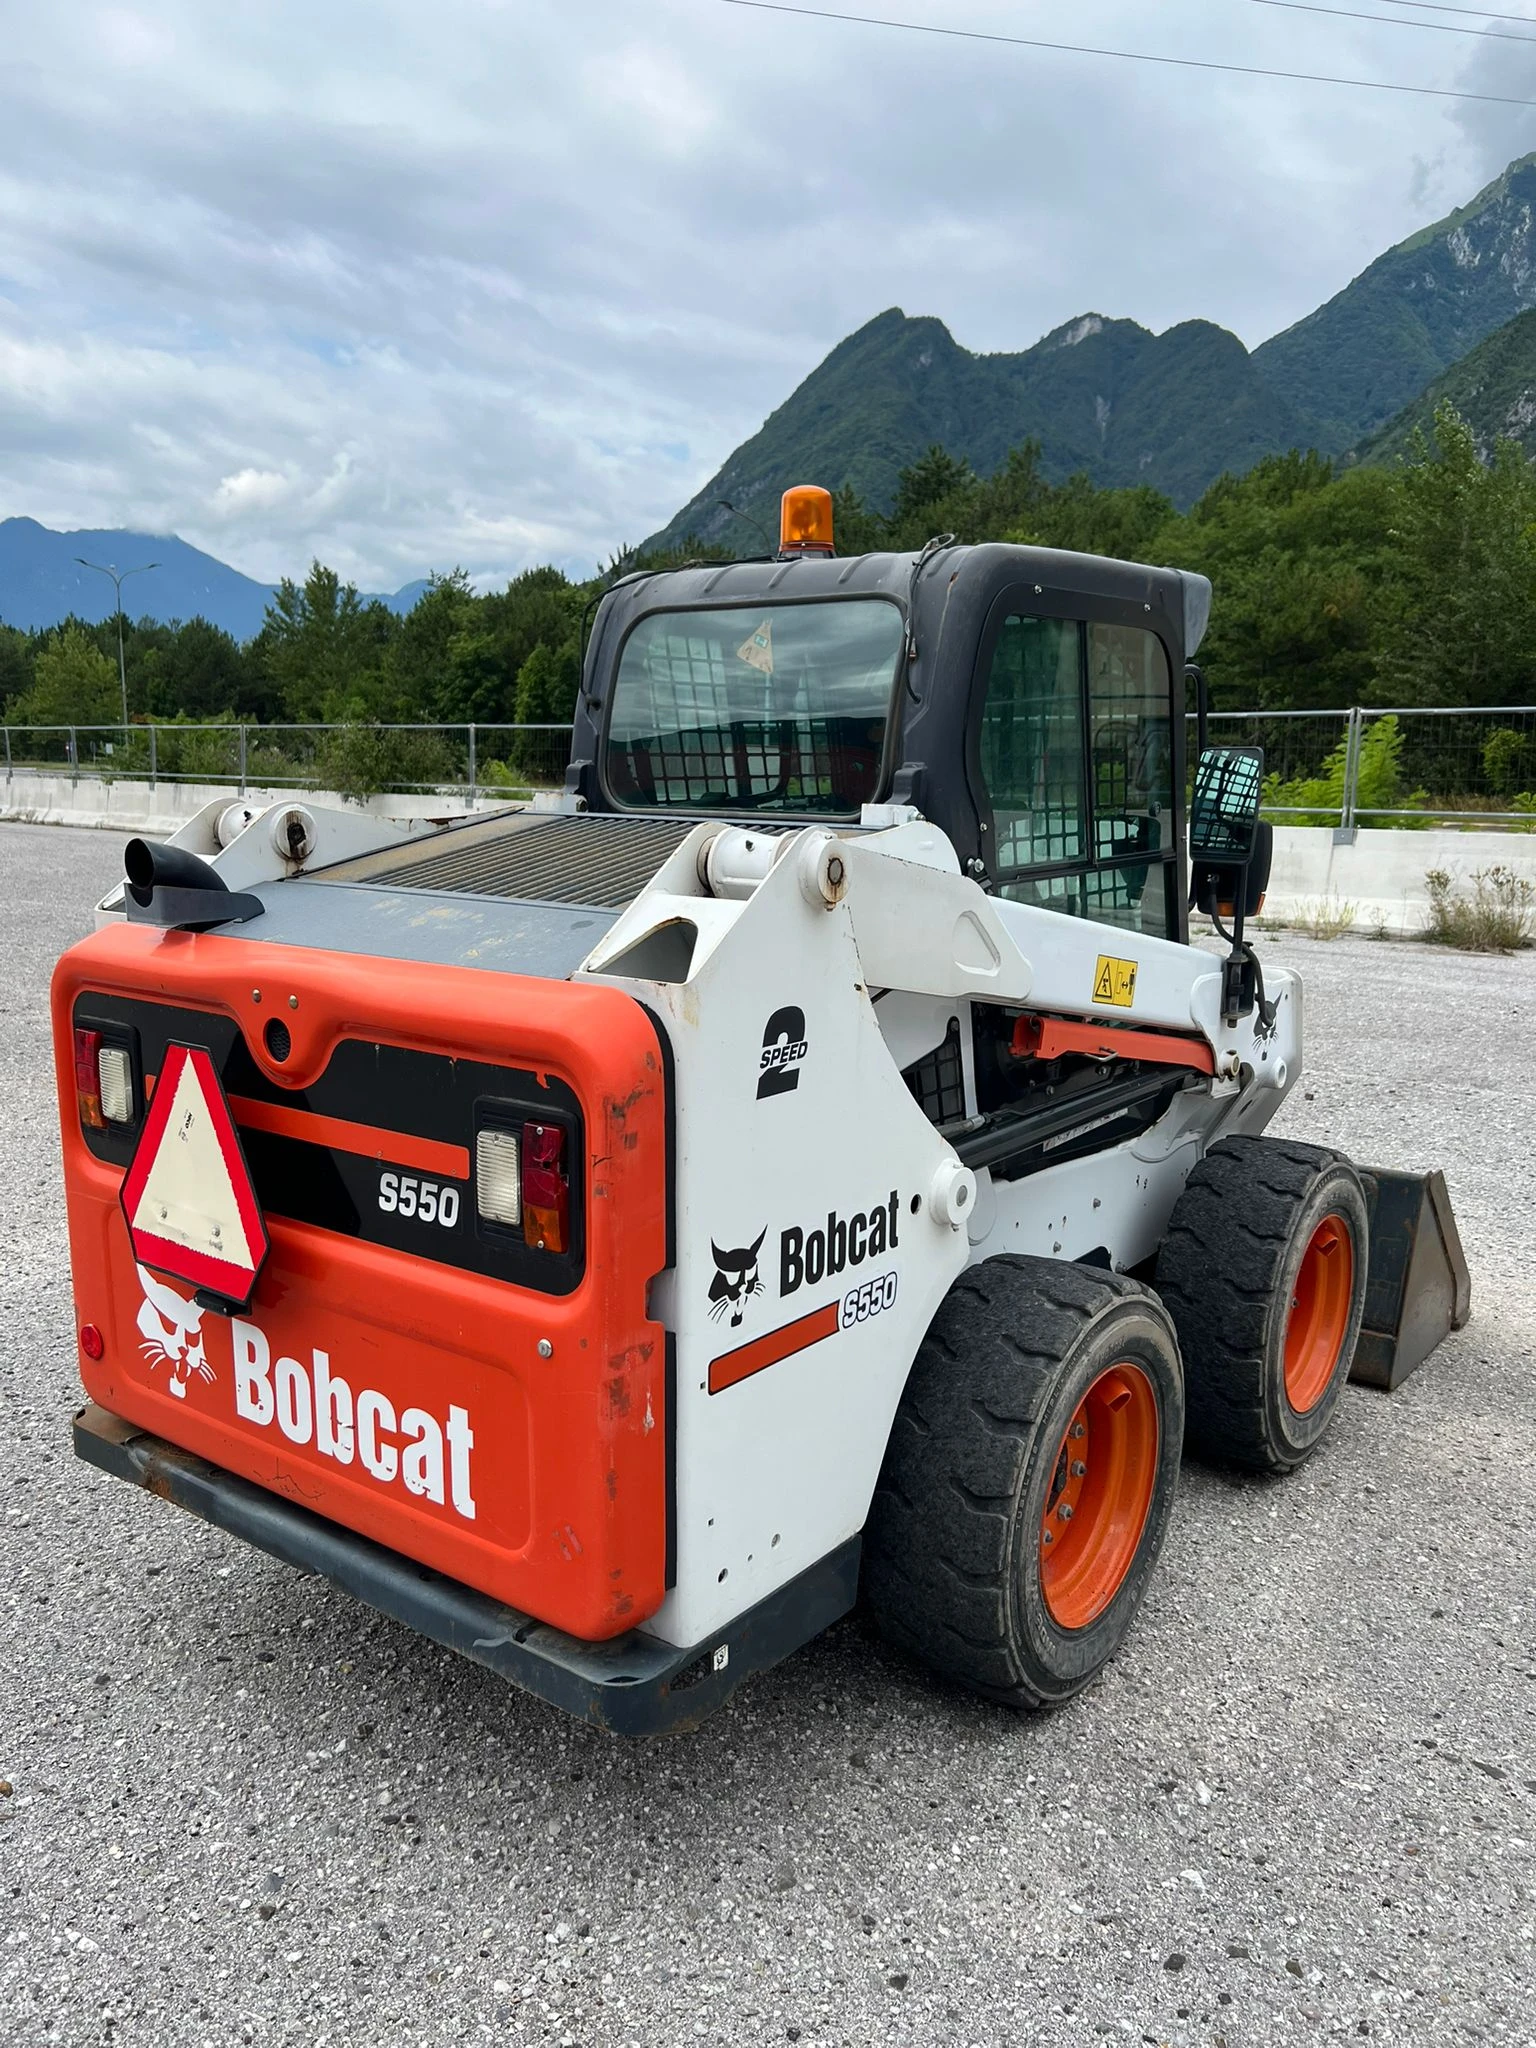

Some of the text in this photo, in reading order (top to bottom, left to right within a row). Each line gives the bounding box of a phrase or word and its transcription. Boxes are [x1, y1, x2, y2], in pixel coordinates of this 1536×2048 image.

[756, 1006, 806, 1100] 2
[760, 1041, 809, 1070] SPEED
[379, 1172, 459, 1228] S550
[779, 1191, 899, 1297] Bobcat
[843, 1272, 898, 1329] S550
[233, 1319, 476, 1520] Bobcat
